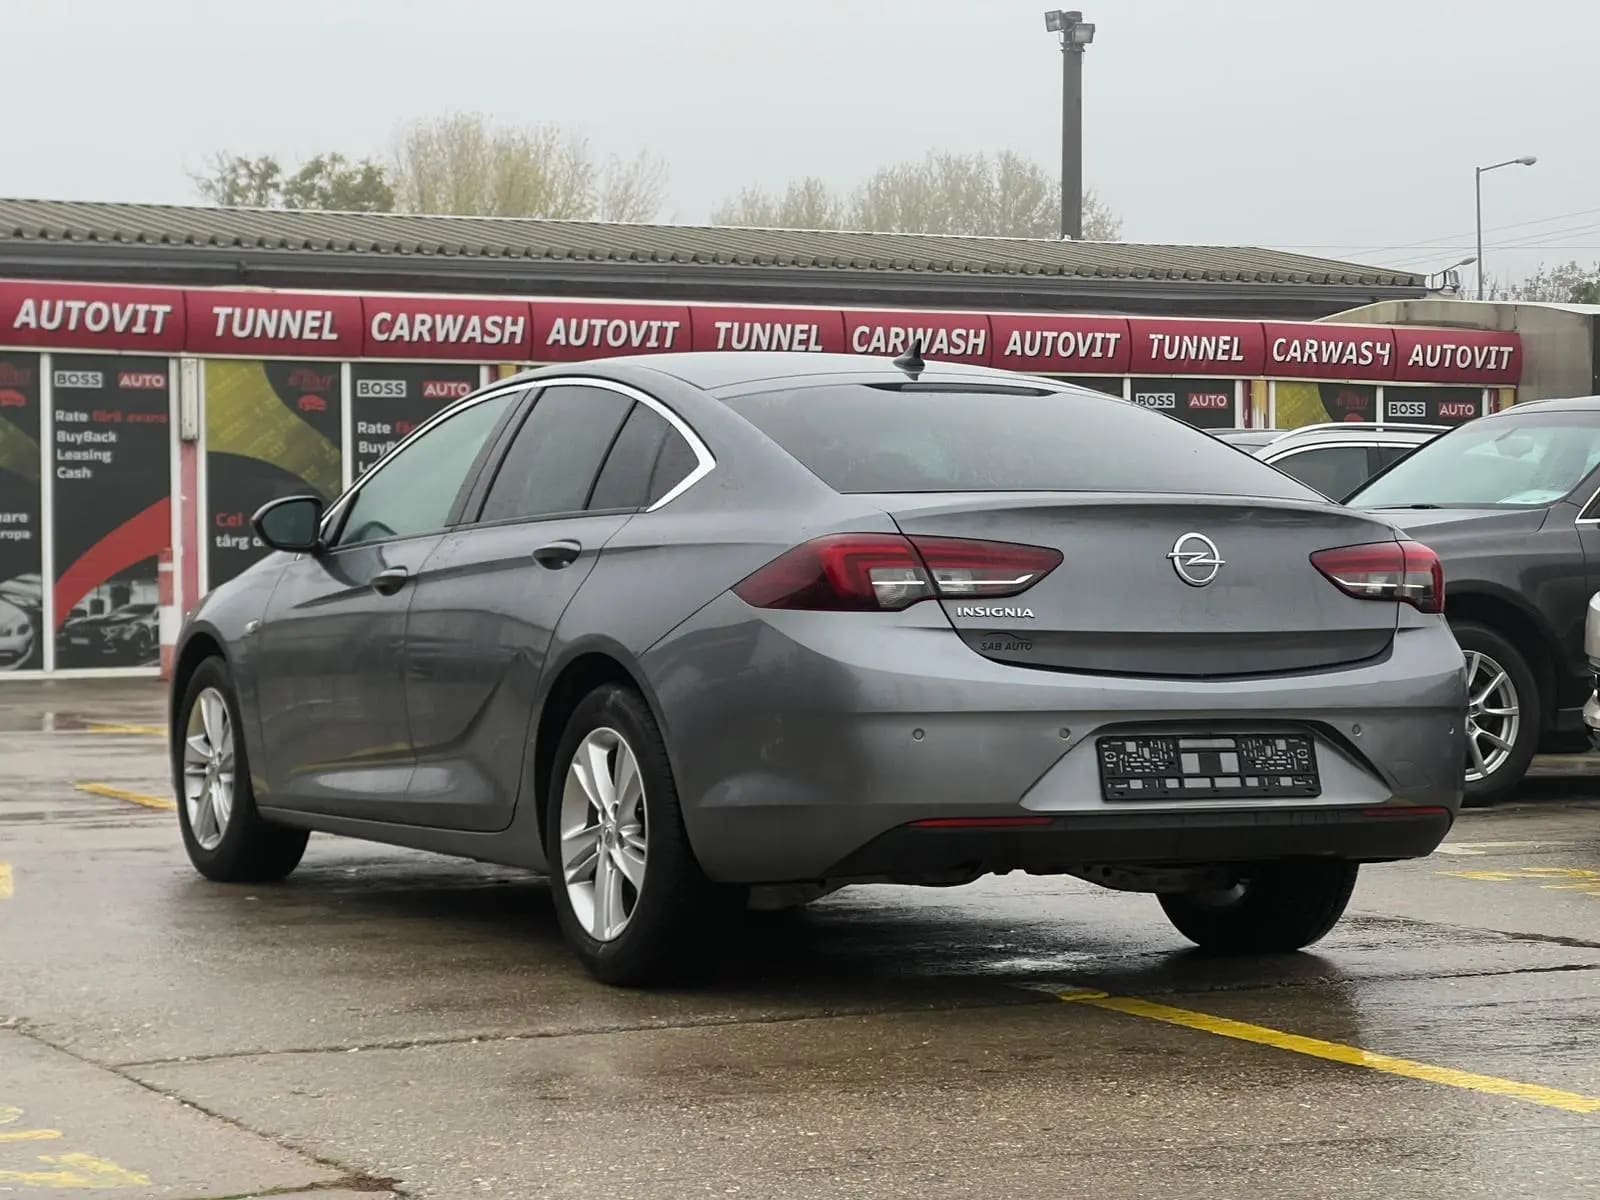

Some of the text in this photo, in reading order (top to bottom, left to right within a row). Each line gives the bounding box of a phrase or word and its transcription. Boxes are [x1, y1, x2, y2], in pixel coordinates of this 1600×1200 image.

[13, 298, 173, 336] AUTOVIT
[212, 306, 339, 341] TUNNEL
[370, 311, 526, 346] CARWASH
[546, 317, 681, 349] AUTOVIT
[714, 321, 824, 352] TUNNEL
[851, 325, 987, 356] CARWASH
[1004, 330, 1122, 358] AUTOVIT
[1148, 333, 1245, 362] TUNNEL
[1407, 344, 1514, 371] AUTOVIT
[56, 373, 165, 387] BOSS AUTO
[359, 382, 471, 397] BOSS AUTO
[1138, 394, 1228, 407] BOSS AUTO
[55, 409, 89, 422] Rate
[1390, 403, 1475, 416] BOSS AUTO
[357, 421, 392, 434] Rate
[56, 430, 117, 445] BuyBack
[358, 441, 397, 456] BuyB
[56, 449, 112, 464] Leasing
[56, 466, 93, 479] Cash
[0, 512, 28, 523] are
[0, 531, 31, 542] ropa
[956, 607, 1035, 619] INSIGNIA
[980, 642, 1033, 651] SAB AUTO
